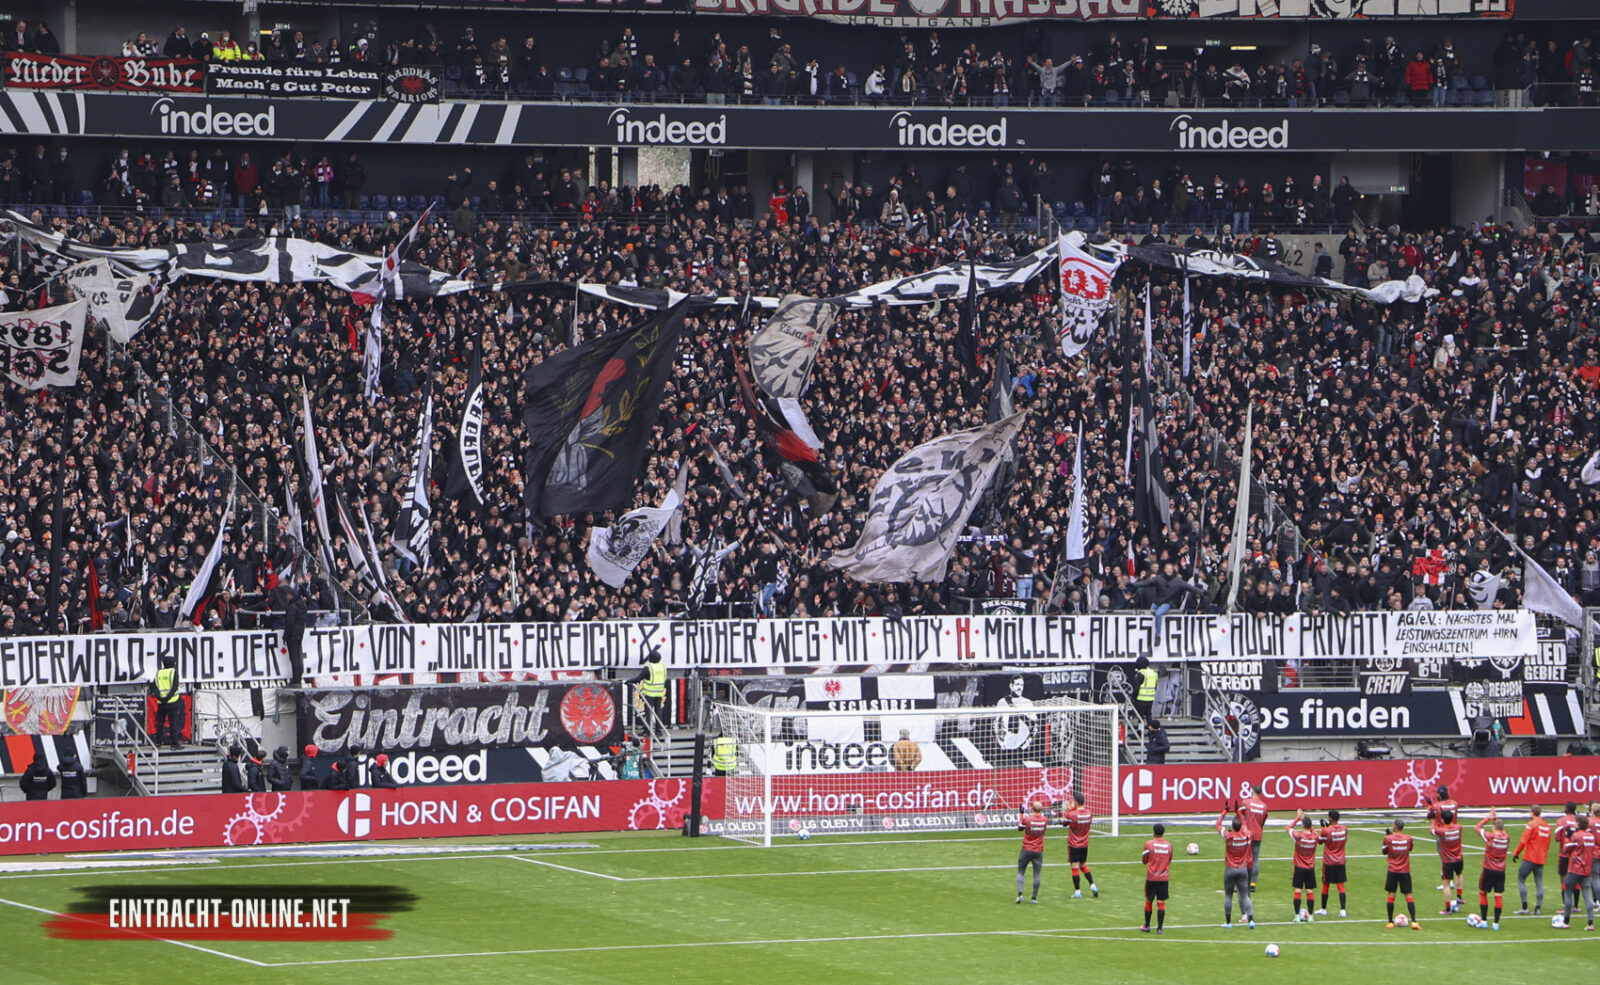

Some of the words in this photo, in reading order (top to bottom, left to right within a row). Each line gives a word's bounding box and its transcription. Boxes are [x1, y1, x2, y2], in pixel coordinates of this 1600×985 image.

[848, 15, 993, 27] HOOLIGANS
[10, 57, 87, 83] Nieder
[123, 60, 197, 88] Bube
[208, 63, 282, 77] Freunde
[284, 67, 322, 78] fürs
[326, 68, 379, 81] Leben
[283, 82, 319, 93] Gut
[321, 83, 371, 95] Peter
[154, 100, 275, 138] indeed
[611, 109, 727, 145] indeed
[891, 113, 1008, 148] indeed
[1173, 116, 1289, 150] indeed
[1497, 612, 1517, 625] MAL
[1396, 627, 1488, 641] LEISTUNGSZENTRUM
[1493, 628, 1519, 640] HIRN
[232, 633, 281, 679] DER
[310, 629, 360, 673] TEIL
[369, 624, 416, 671] VON
[522, 622, 632, 669] ERREICHT
[670, 620, 757, 665] FRÜHER
[769, 619, 821, 664] WEG
[831, 617, 871, 663] MIT
[883, 617, 943, 661] ANDY
[956, 617, 976, 660] H.
[984, 615, 1082, 660] MÖLLER.
[1089, 616, 1154, 660] ALLES
[1165, 615, 1219, 658] GUTE
[1230, 613, 1285, 657] AUCH
[1300, 612, 1388, 657] PRIVAT!
[1402, 641, 1474, 655] EINSCHALTEN!
[1200, 661, 1263, 675] STADION
[1525, 665, 1568, 681] GEBIET
[1201, 675, 1263, 691] VERBOT
[1365, 674, 1407, 695] CREW
[1488, 680, 1523, 698] REGION
[311, 688, 550, 753] Eintracht
[1300, 698, 1410, 729] finden
[784, 741, 897, 771] indee
[1162, 776, 1232, 802] HORN
[1239, 781, 1252, 799] &
[1261, 773, 1363, 799] COSIFAN
[1488, 767, 1600, 794] www.hor
[735, 782, 994, 814] www.horn-cosifan.de
[381, 799, 458, 827] HORN
[467, 804, 482, 823] &
[490, 794, 600, 822] COSIFAN
[895, 816, 910, 827] LG
[914, 816, 941, 827] OLED
[942, 815, 957, 826] TV
[986, 814, 1001, 824] LG
[802, 819, 817, 829] LG
[821, 818, 848, 829] OLED
[849, 817, 864, 828] TV
